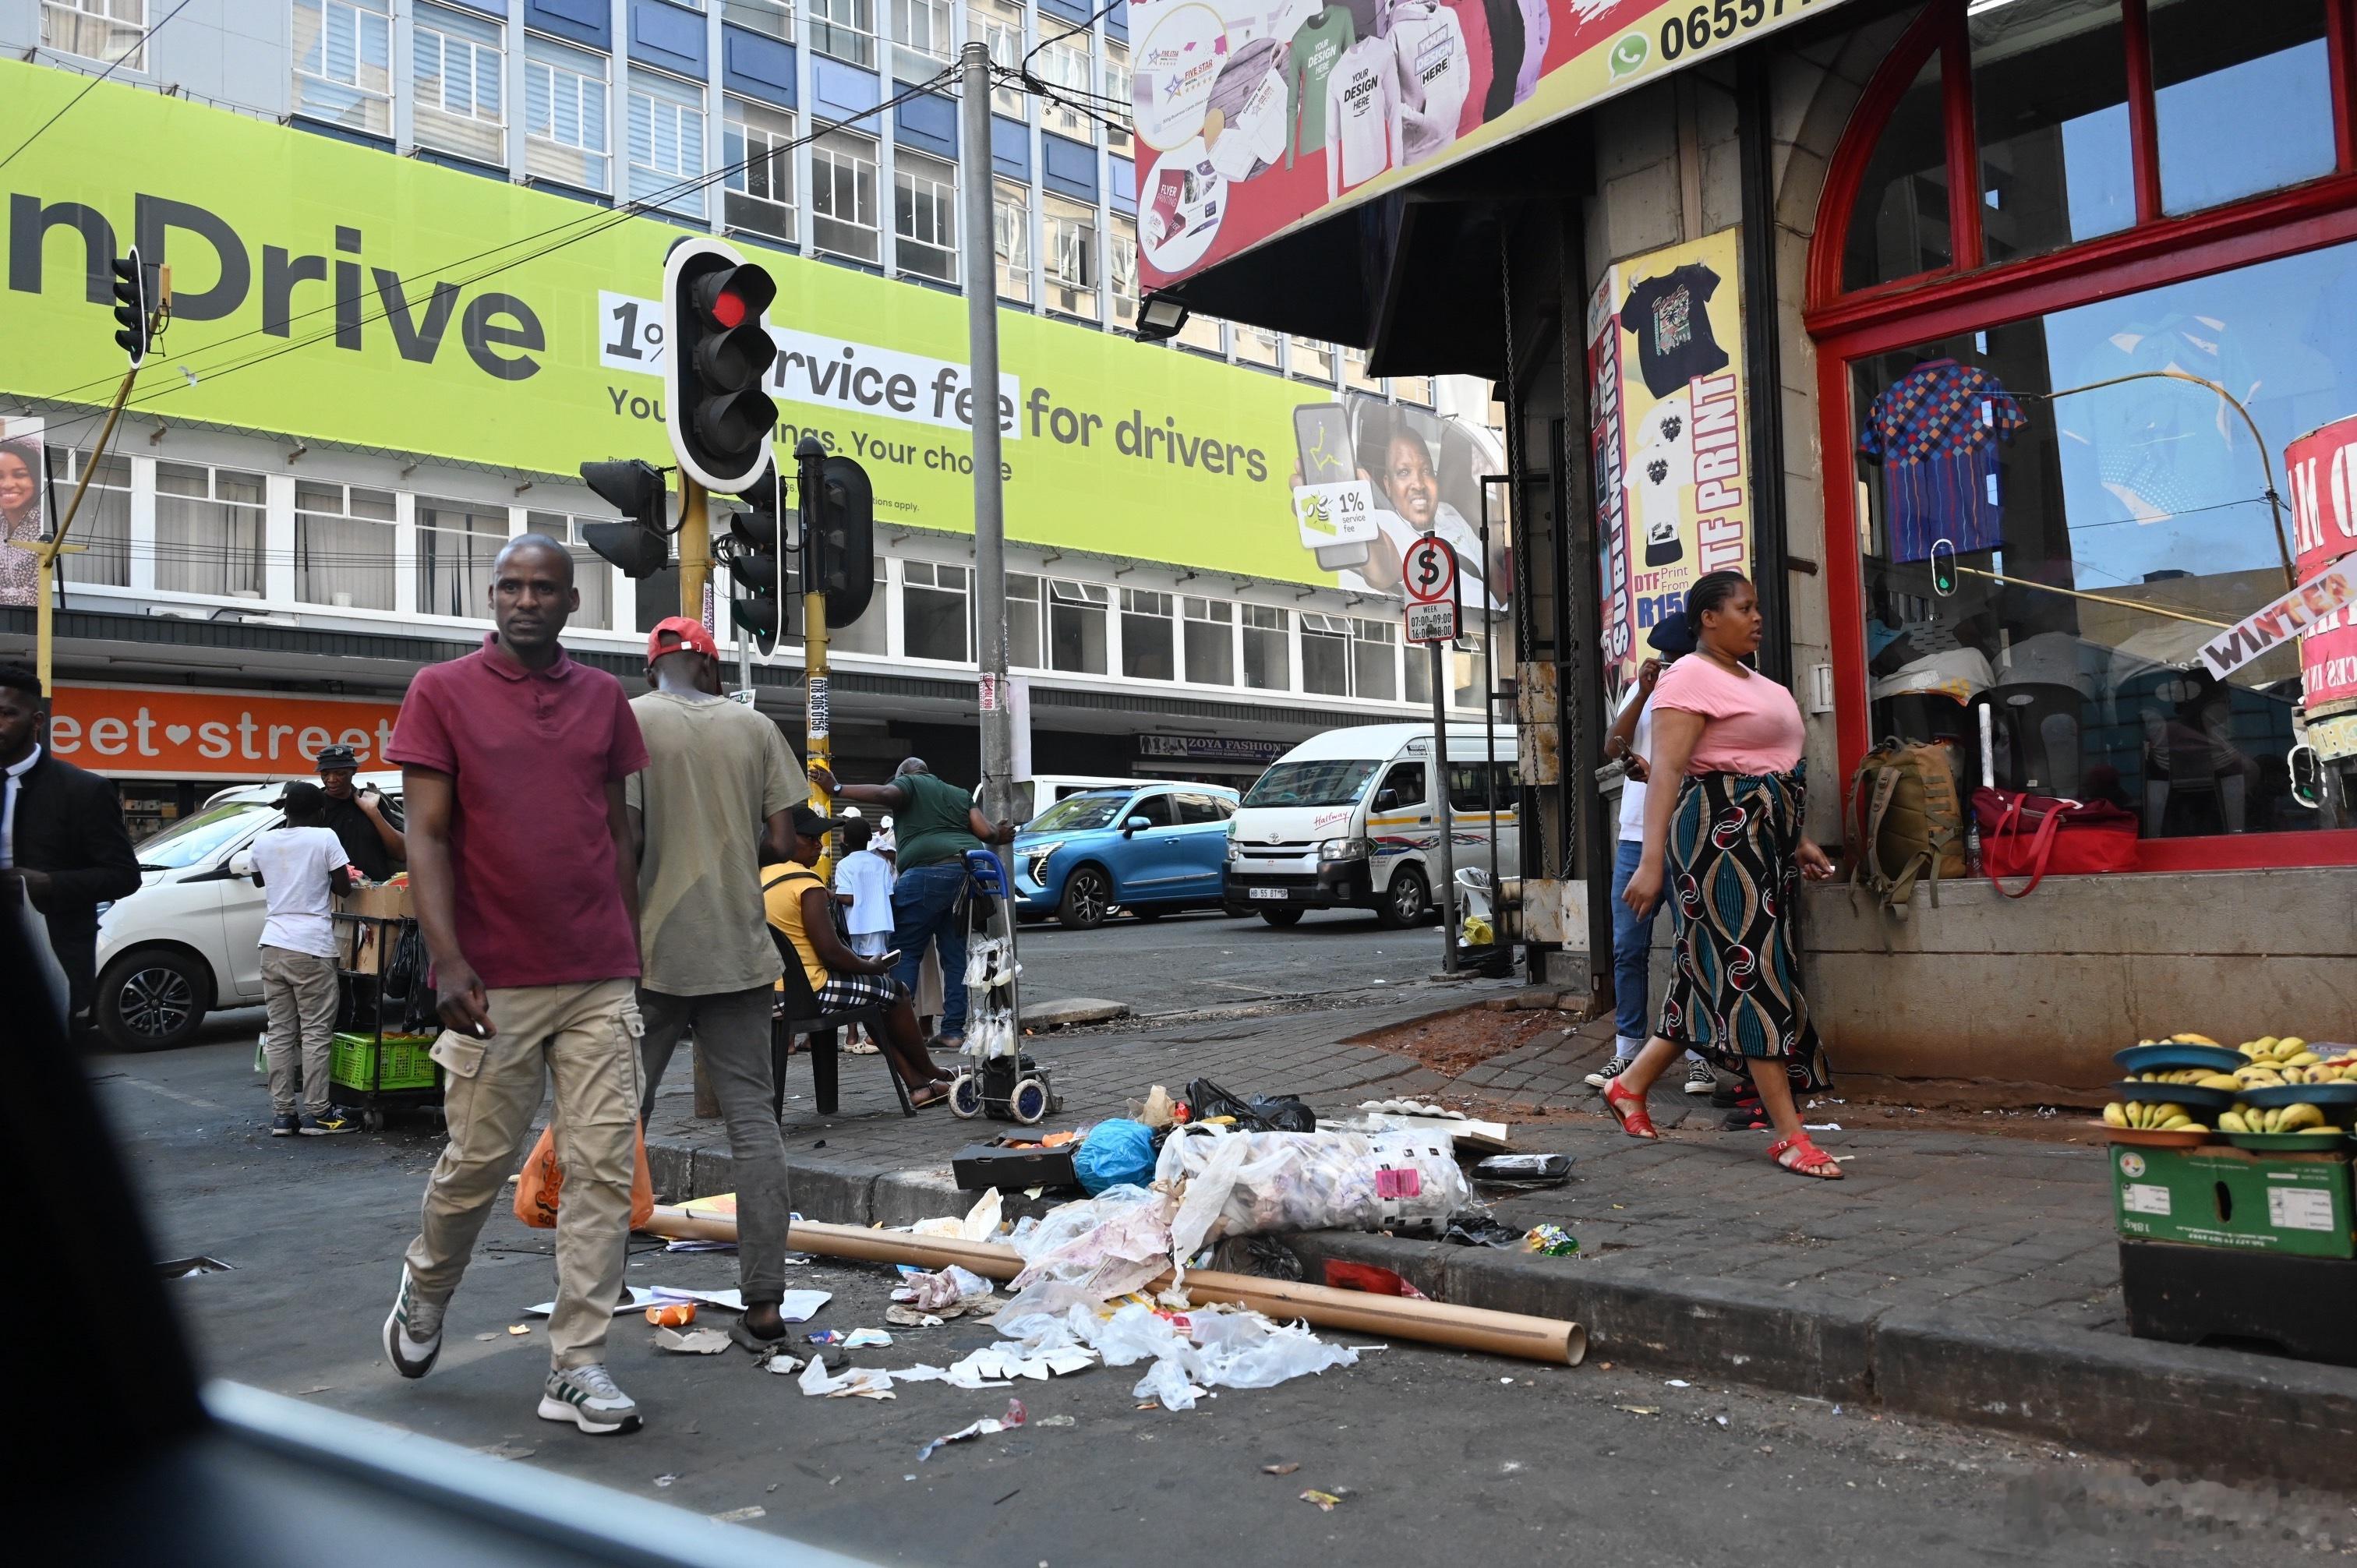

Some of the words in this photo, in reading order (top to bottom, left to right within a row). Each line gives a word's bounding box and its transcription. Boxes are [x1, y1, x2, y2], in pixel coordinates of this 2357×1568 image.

[1661, 0, 1811, 61] 0655
[1315, 39, 1328, 51] YOUR
[1420, 27, 1446, 54] YOUR
[1308, 44, 1336, 69] DESIGN
[1416, 41, 1453, 74] DESIGN
[1185, 67, 1197, 80] FIVE
[1198, 59, 1213, 72] STAR
[1316, 61, 1330, 75] HERE
[1352, 68, 1369, 83] YOUR
[1422, 58, 1448, 85] HERE
[1257, 78, 1268, 92] Name
[1345, 75, 1378, 103] DESIGN
[1353, 94, 1370, 111] HERE
[1156, 192, 1178, 207] PRINTING
[1161, 184, 1178, 197] FLYER
[607, 387, 666, 422] You
[851, 430, 916, 465] Your
[924, 445, 1012, 482] choe
[1027, 387, 1103, 447] for
[1115, 409, 1267, 482] drivers
[1691, 375, 1741, 513] PRINT
[1603, 322, 1629, 657] SUBLIMATION
[894, 501, 920, 511] apply.
[1339, 492, 1364, 513] 1%
[1342, 514, 1366, 523] service
[1344, 524, 1355, 533] fee
[1698, 517, 1743, 575] TF
[1634, 572, 1660, 592] DTF
[1661, 567, 1688, 579] Print
[1661, 580, 1689, 592] From
[1423, 605, 1437, 613] WEEK
[2205, 574, 2353, 671] WINTER
[811, 679, 824, 693] 078
[811, 695, 825, 710] 306
[811, 712, 825, 731] 0156
[51, 707, 160, 756] eet
[198, 711, 393, 764] street
[1188, 739, 1222, 749] ZOYA
[1225, 740, 1281, 752] FASHION
[1314, 810, 1348, 827] Halfway
[2124, 1219, 2150, 1234] 18kg
